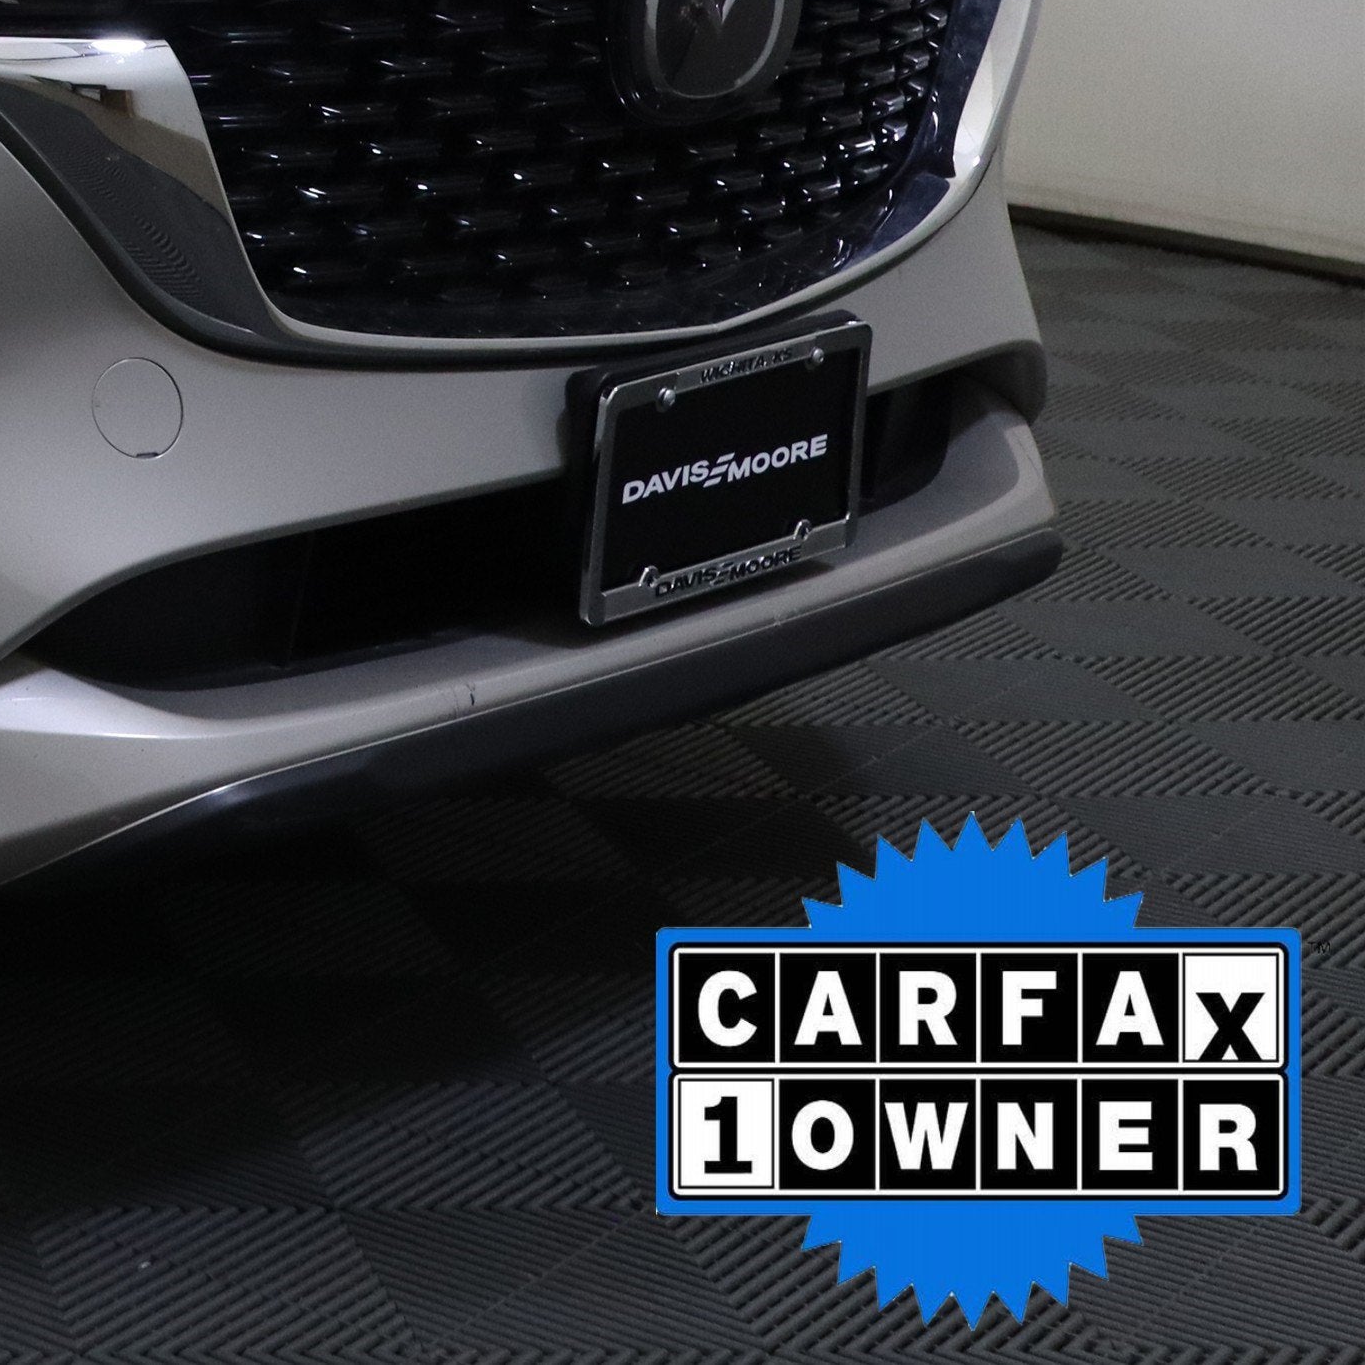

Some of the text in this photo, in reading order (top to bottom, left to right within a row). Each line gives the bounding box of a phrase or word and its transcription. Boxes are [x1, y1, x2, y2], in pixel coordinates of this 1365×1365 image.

[621, 434, 828, 504] DAVIS MOORE
[655, 545, 803, 597] DAVIS MOORE
